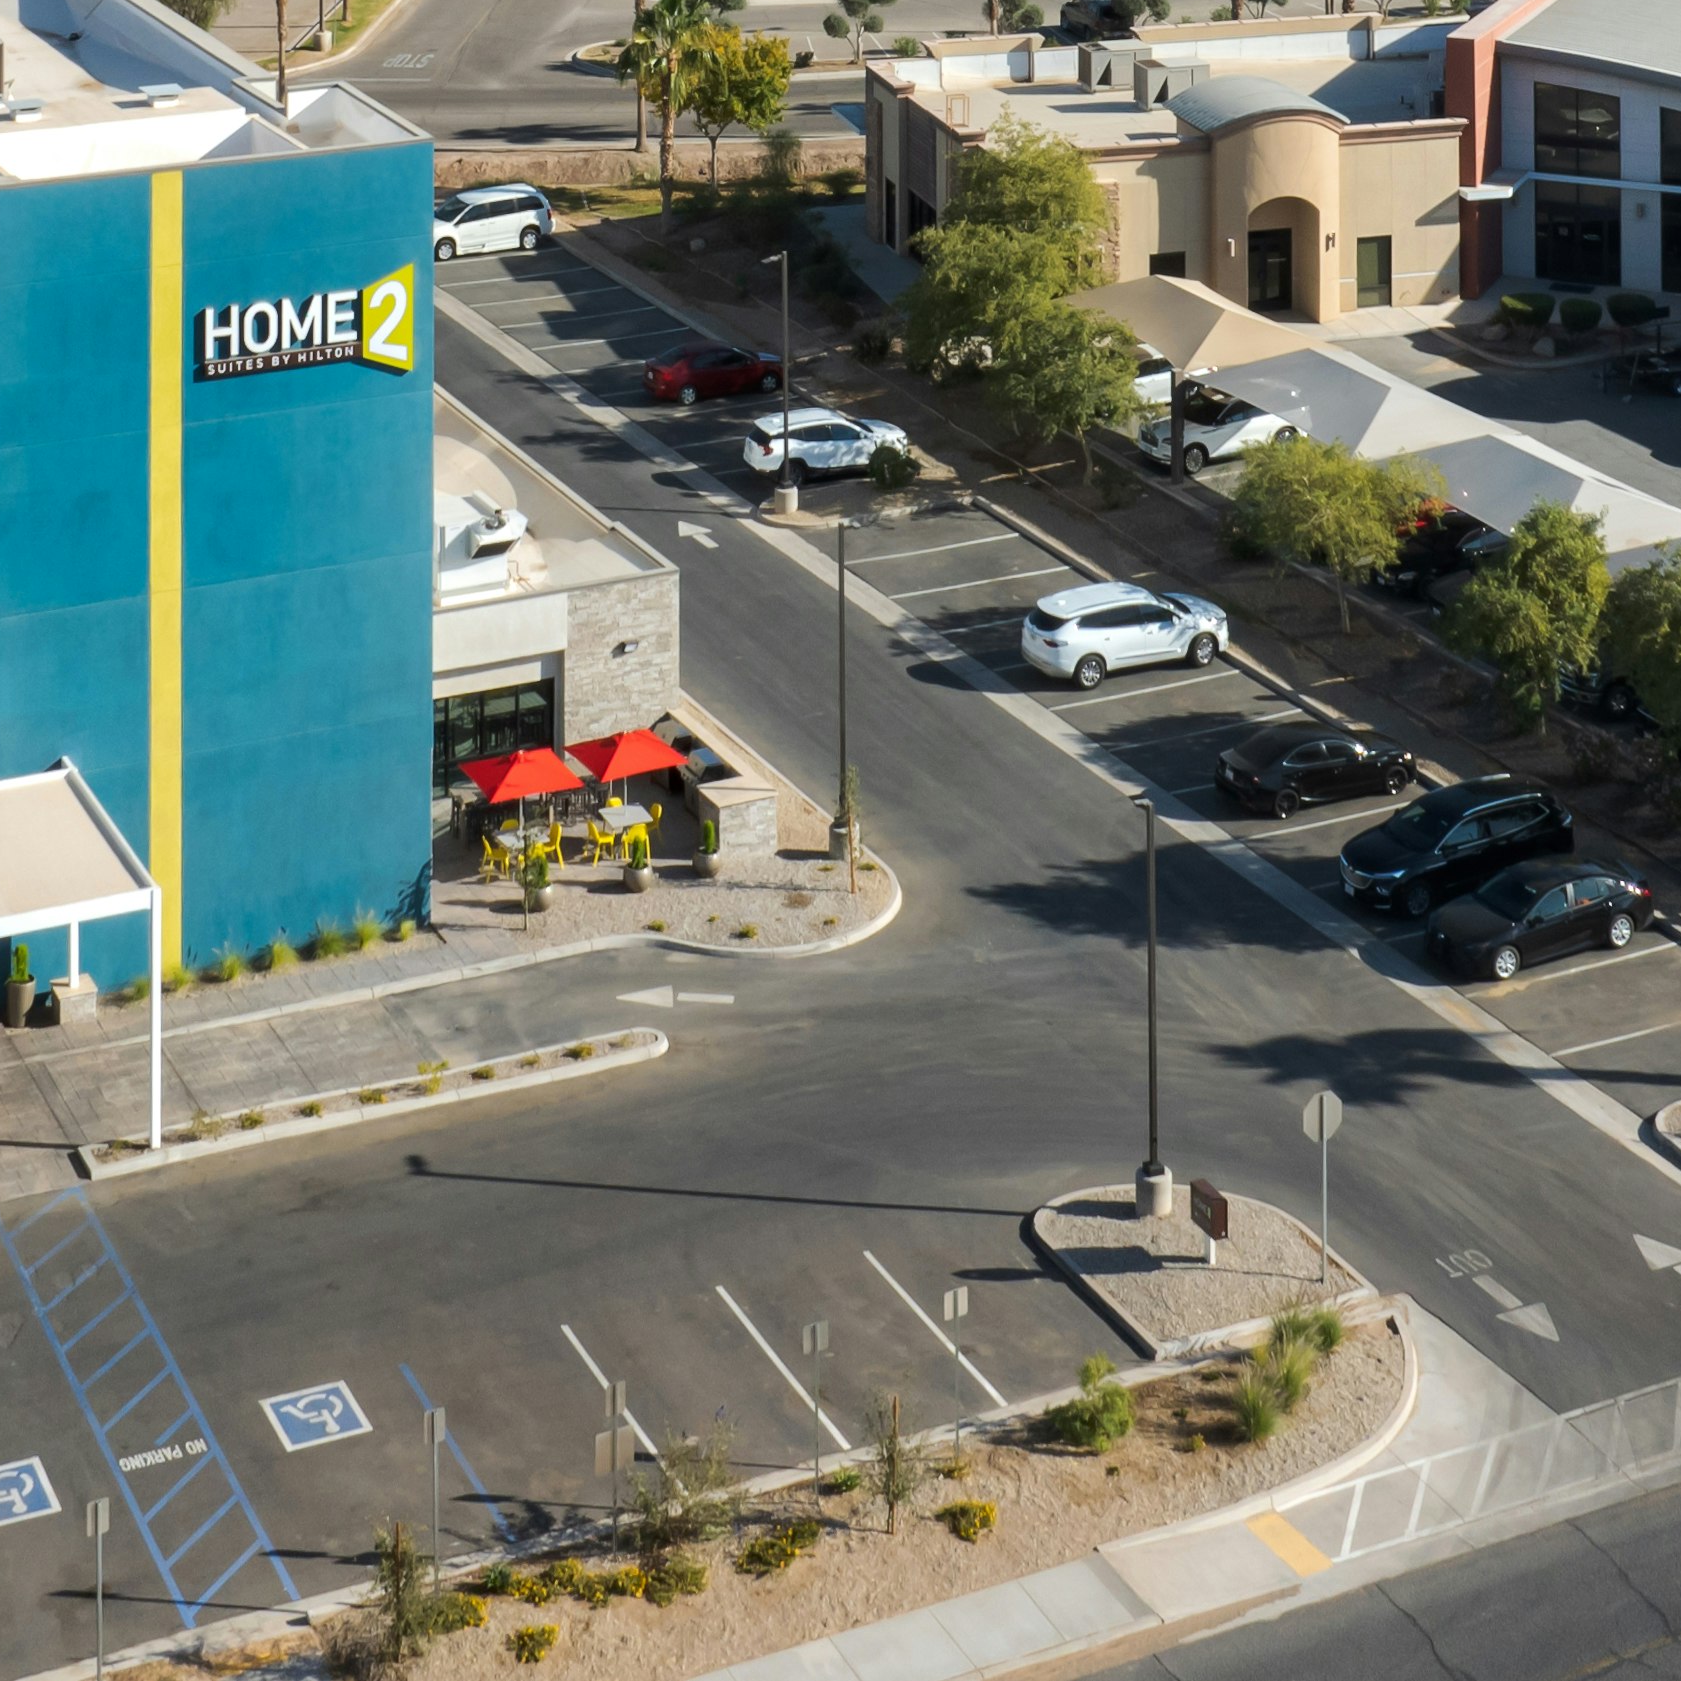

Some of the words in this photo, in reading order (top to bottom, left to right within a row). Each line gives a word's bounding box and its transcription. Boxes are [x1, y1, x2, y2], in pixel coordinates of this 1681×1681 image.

[204, 289, 358, 360] HOME
[369, 280, 409, 361] 2
[207, 356, 264, 376] SUITES
[271, 352, 291, 366] BY
[297, 345, 355, 363] HILTON
[1435, 1249, 1493, 1279] OUT
[118, 1443, 184, 1473] PARKING
[185, 1437, 209, 1456] NO
